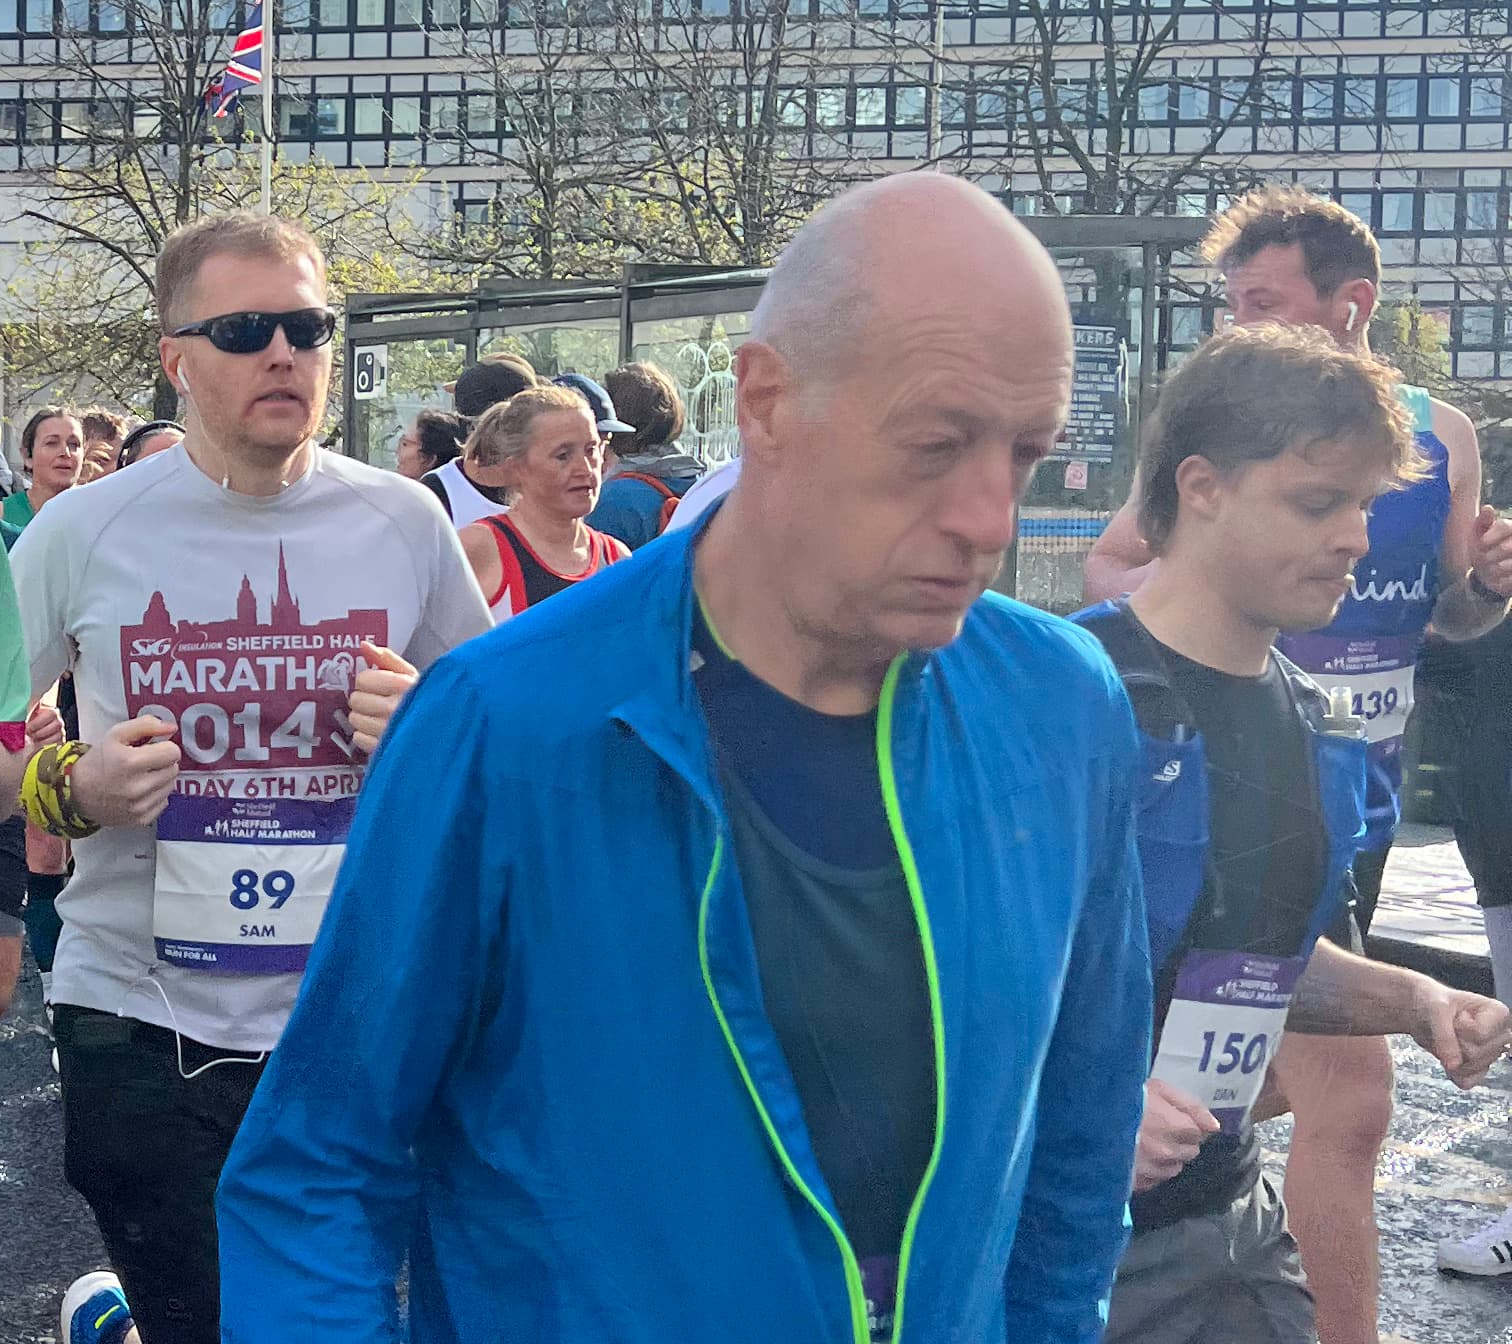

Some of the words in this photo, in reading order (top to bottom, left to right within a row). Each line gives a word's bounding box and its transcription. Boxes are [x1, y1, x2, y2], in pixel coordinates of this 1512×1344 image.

[226, 635, 323, 651] SHEFFIELD
[329, 634, 376, 649] HALF
[175, 777, 235, 798] DAY
[243, 776, 296, 799] 6TH
[305, 772, 363, 796] APR
[231, 819, 280, 828] SHEFFIELD
[230, 828, 256, 838] HALF
[257, 829, 316, 839] MARATHON
[228, 868, 296, 910] 89
[239, 924, 276, 938] SAM
[1198, 1030, 1268, 1075] 150
